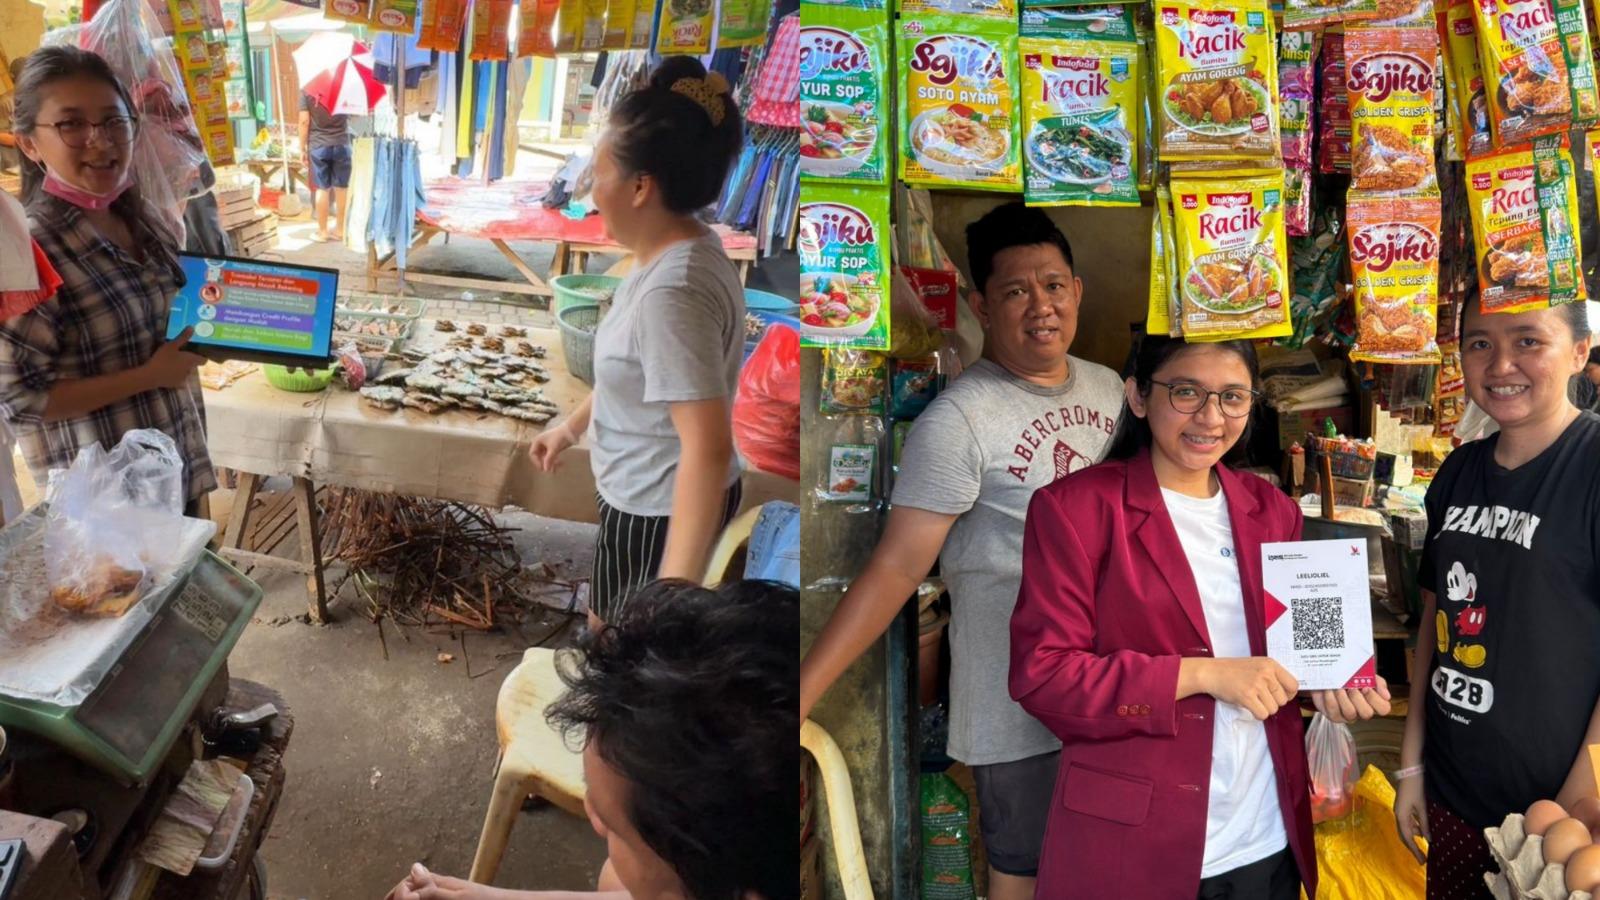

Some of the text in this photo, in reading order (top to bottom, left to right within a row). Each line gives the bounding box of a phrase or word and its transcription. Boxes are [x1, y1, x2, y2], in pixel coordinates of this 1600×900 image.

[1191, 12, 1231, 24] Indofood
[1558, 11, 1575, 23] BELI
[1561, 20, 1583, 34] GRATIS
[1179, 26, 1246, 59] Racik
[1057, 60, 1095, 68] Indofood
[1200, 58, 1228, 66] Bumbu
[1180, 66, 1246, 82] AYAM GORENG
[1348, 61, 1434, 102] Sajiku
[801, 82, 864, 98] YUR SOP
[918, 86, 998, 105] SOTO AYAM
[1398, 106, 1434, 117] CRISPY
[1281, 118, 1308, 130] inso
[1284, 188, 1301, 197] nso
[1200, 206, 1264, 240] Racik
[1488, 213, 1524, 226] Tepung
[800, 213, 875, 248] jiku
[1200, 253, 1226, 264] AYAM
[1351, 232, 1438, 272] Sajiku
[841, 256, 868, 269] SOP
[1356, 276, 1395, 288] GOLDEN
[1007, 405, 1114, 482] ABERCROMB
[1434, 505, 1540, 550] HAMPION
